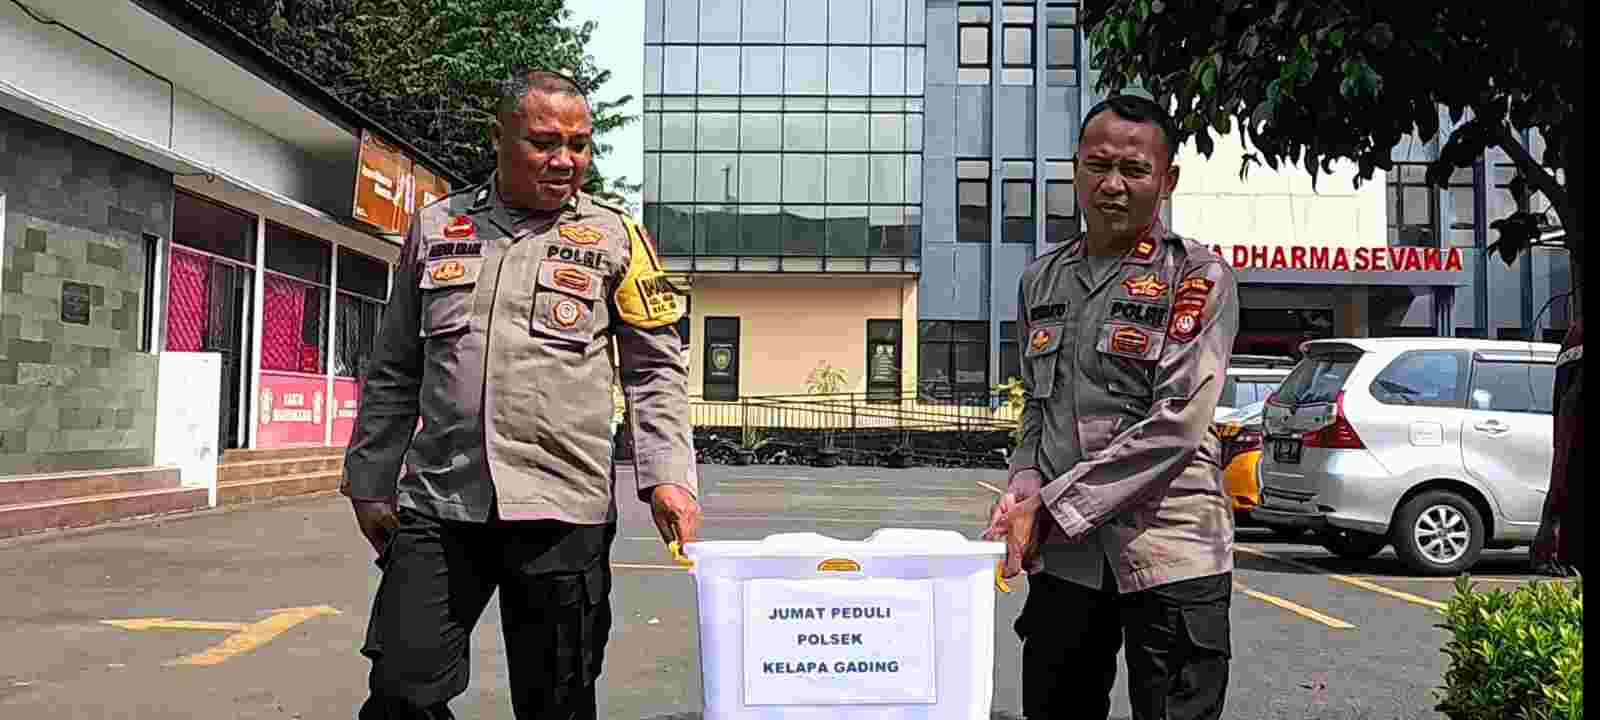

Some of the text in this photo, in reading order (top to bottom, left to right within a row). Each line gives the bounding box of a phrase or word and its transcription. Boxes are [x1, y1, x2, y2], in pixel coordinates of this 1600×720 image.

[546, 244, 603, 268] POLRI
[1231, 244, 1350, 271] DHARMA
[1354, 246, 1463, 271] SEVAKA
[768, 606, 891, 620] JUMAT PEDULI
[797, 633, 863, 646] POLSEK
[762, 660, 899, 674] KELAPA GADING
